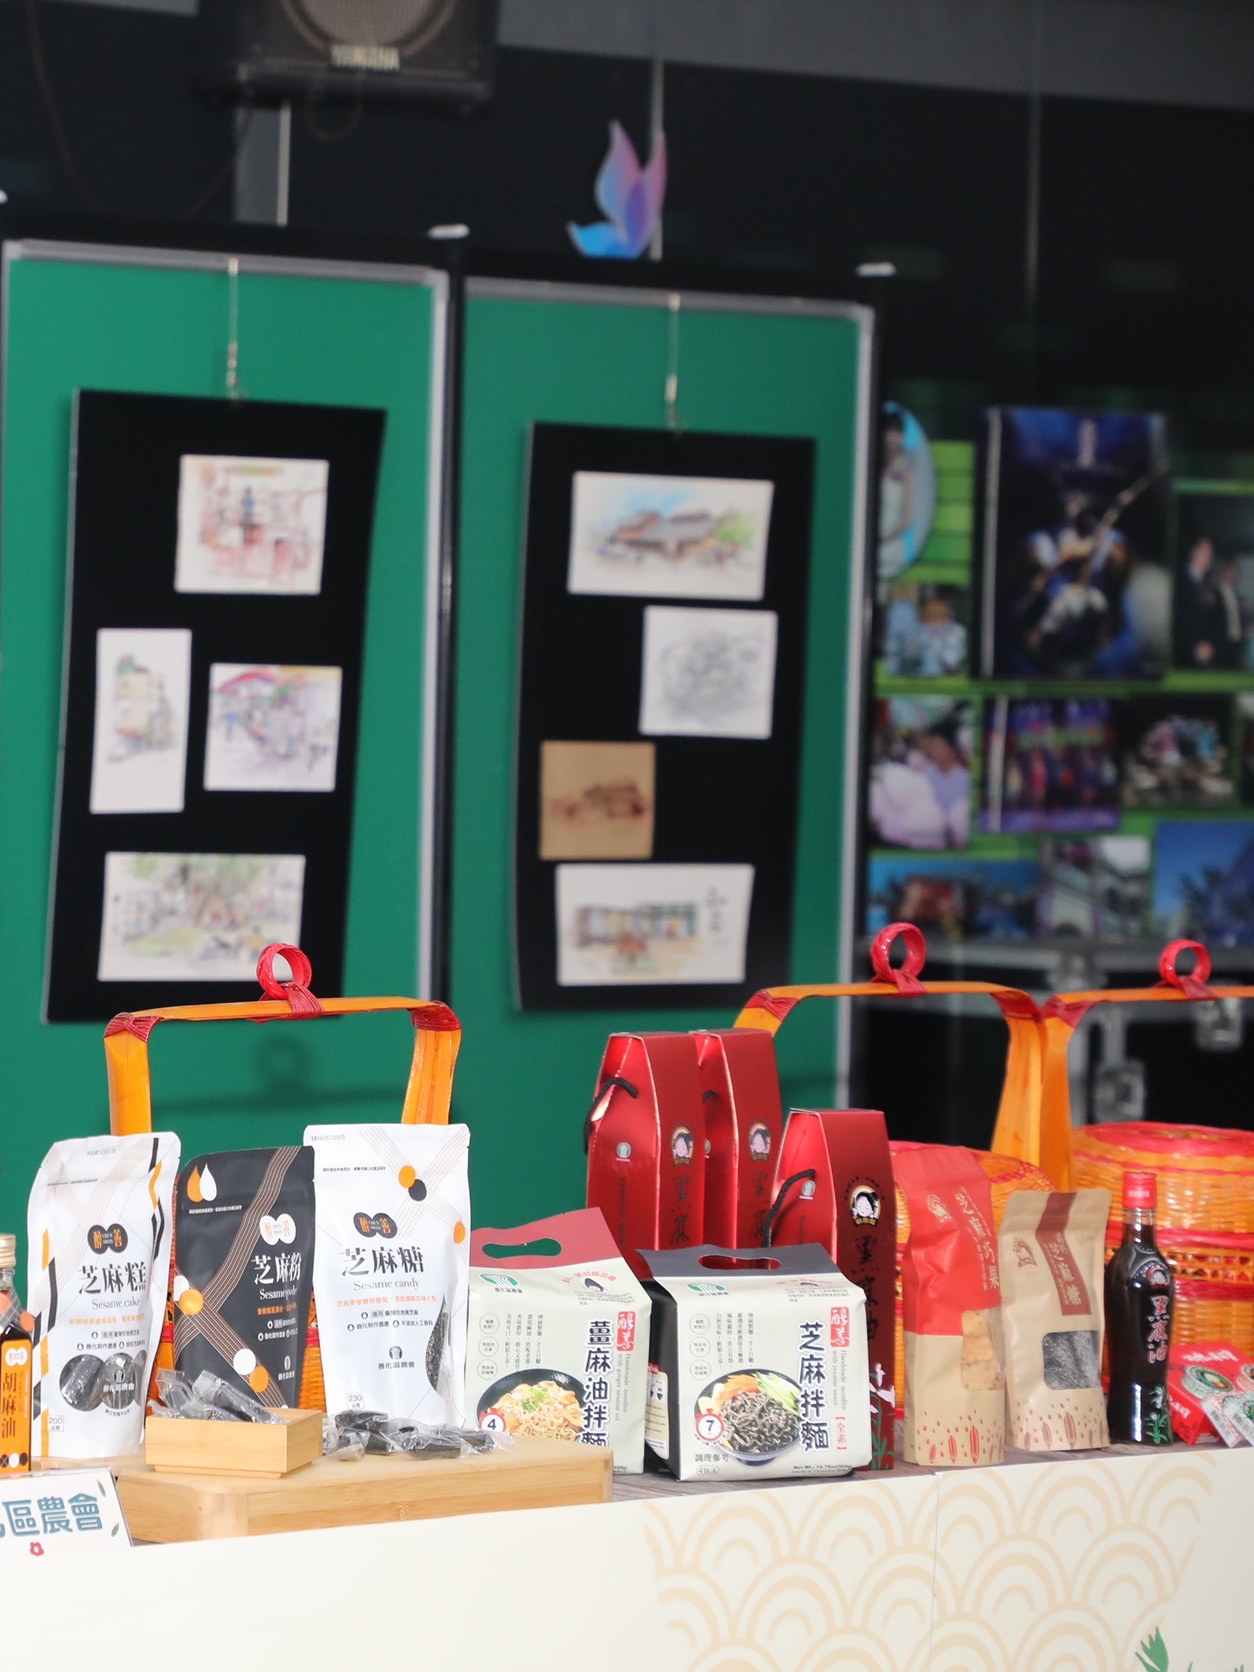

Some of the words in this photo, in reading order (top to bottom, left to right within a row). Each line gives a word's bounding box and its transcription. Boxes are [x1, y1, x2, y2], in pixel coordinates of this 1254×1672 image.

[251, 1252, 302, 1286] 芝麻粉
[340, 1246, 424, 1276] 芝麻糖
[77, 1261, 146, 1295] 芝麻糕
[354, 1278, 393, 1291] Sesame
[395, 1277, 420, 1290] candy
[92, 1299, 122, 1310] Sesame
[124, 1296, 141, 1308] cake
[259, 1288, 286, 1300] Sesame
[618, 1313, 635, 1350] 醇善
[831, 1308, 849, 1347] 醇善
[378, 1361, 415, 1370] 善化區農會
[624, 1353, 632, 1387] Handmade
[840, 1349, 848, 1383] Handmade
[348, 1394, 362, 1403] 230
[581, 1320, 612, 1447] 薑麻油拌麵
[799, 1321, 830, 1452] 芝麻拌麵
[1, 1372, 17, 1439] 胡麻油
[48, 1417, 63, 1425] 200
[487, 1418, 497, 1431] 4
[705, 1419, 715, 1432] 7
[695, 1454, 729, 1463] 調理參考
